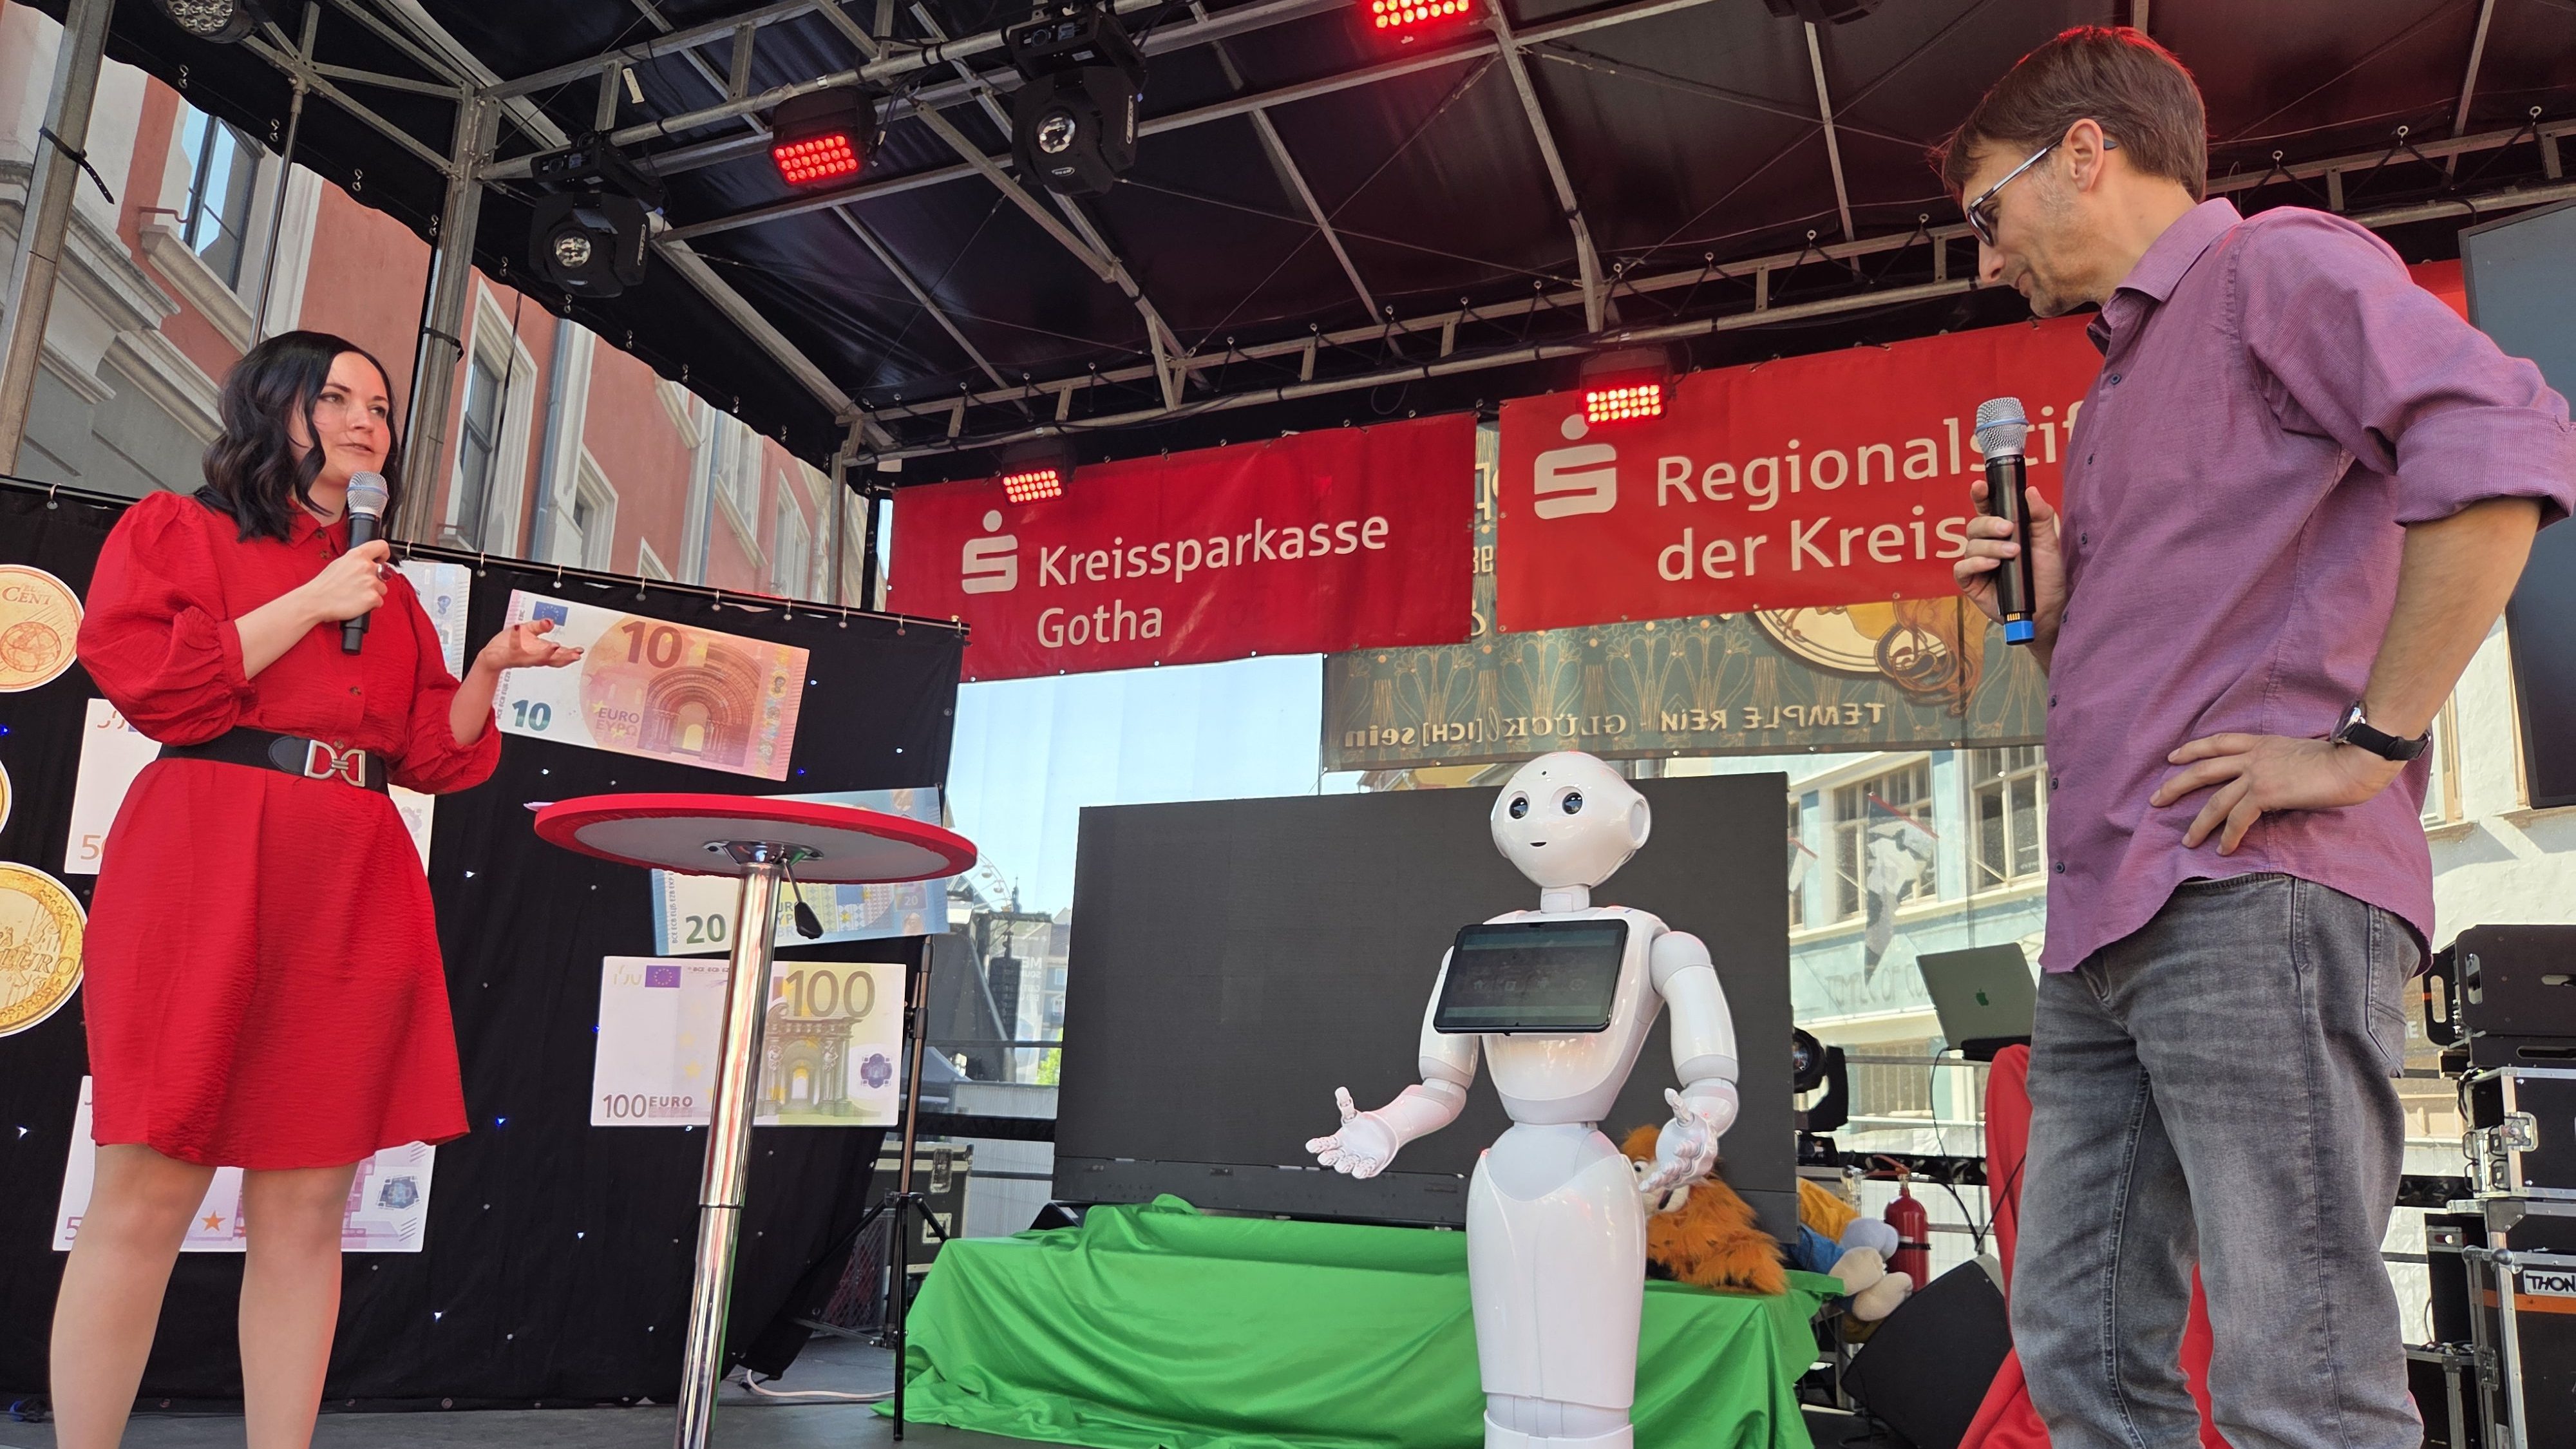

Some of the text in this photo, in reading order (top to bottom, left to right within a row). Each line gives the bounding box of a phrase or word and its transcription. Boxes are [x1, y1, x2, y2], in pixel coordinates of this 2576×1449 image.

[1040, 516, 1389, 587] Kreissparkasse
[1658, 505, 1969, 582] der Kreis
[1037, 600, 1162, 648] Gotha
[621, 621, 683, 668] 10
[512, 699, 551, 731] 10
[598, 707, 639, 724] EURO
[904, 895, 919, 906] 20
[686, 913, 726, 945] 20
[786, 969, 876, 1018] 100
[603, 1094, 647, 1118] 100
[649, 1096, 693, 1107] EURO
[2525, 1275, 2576, 1293] THON
